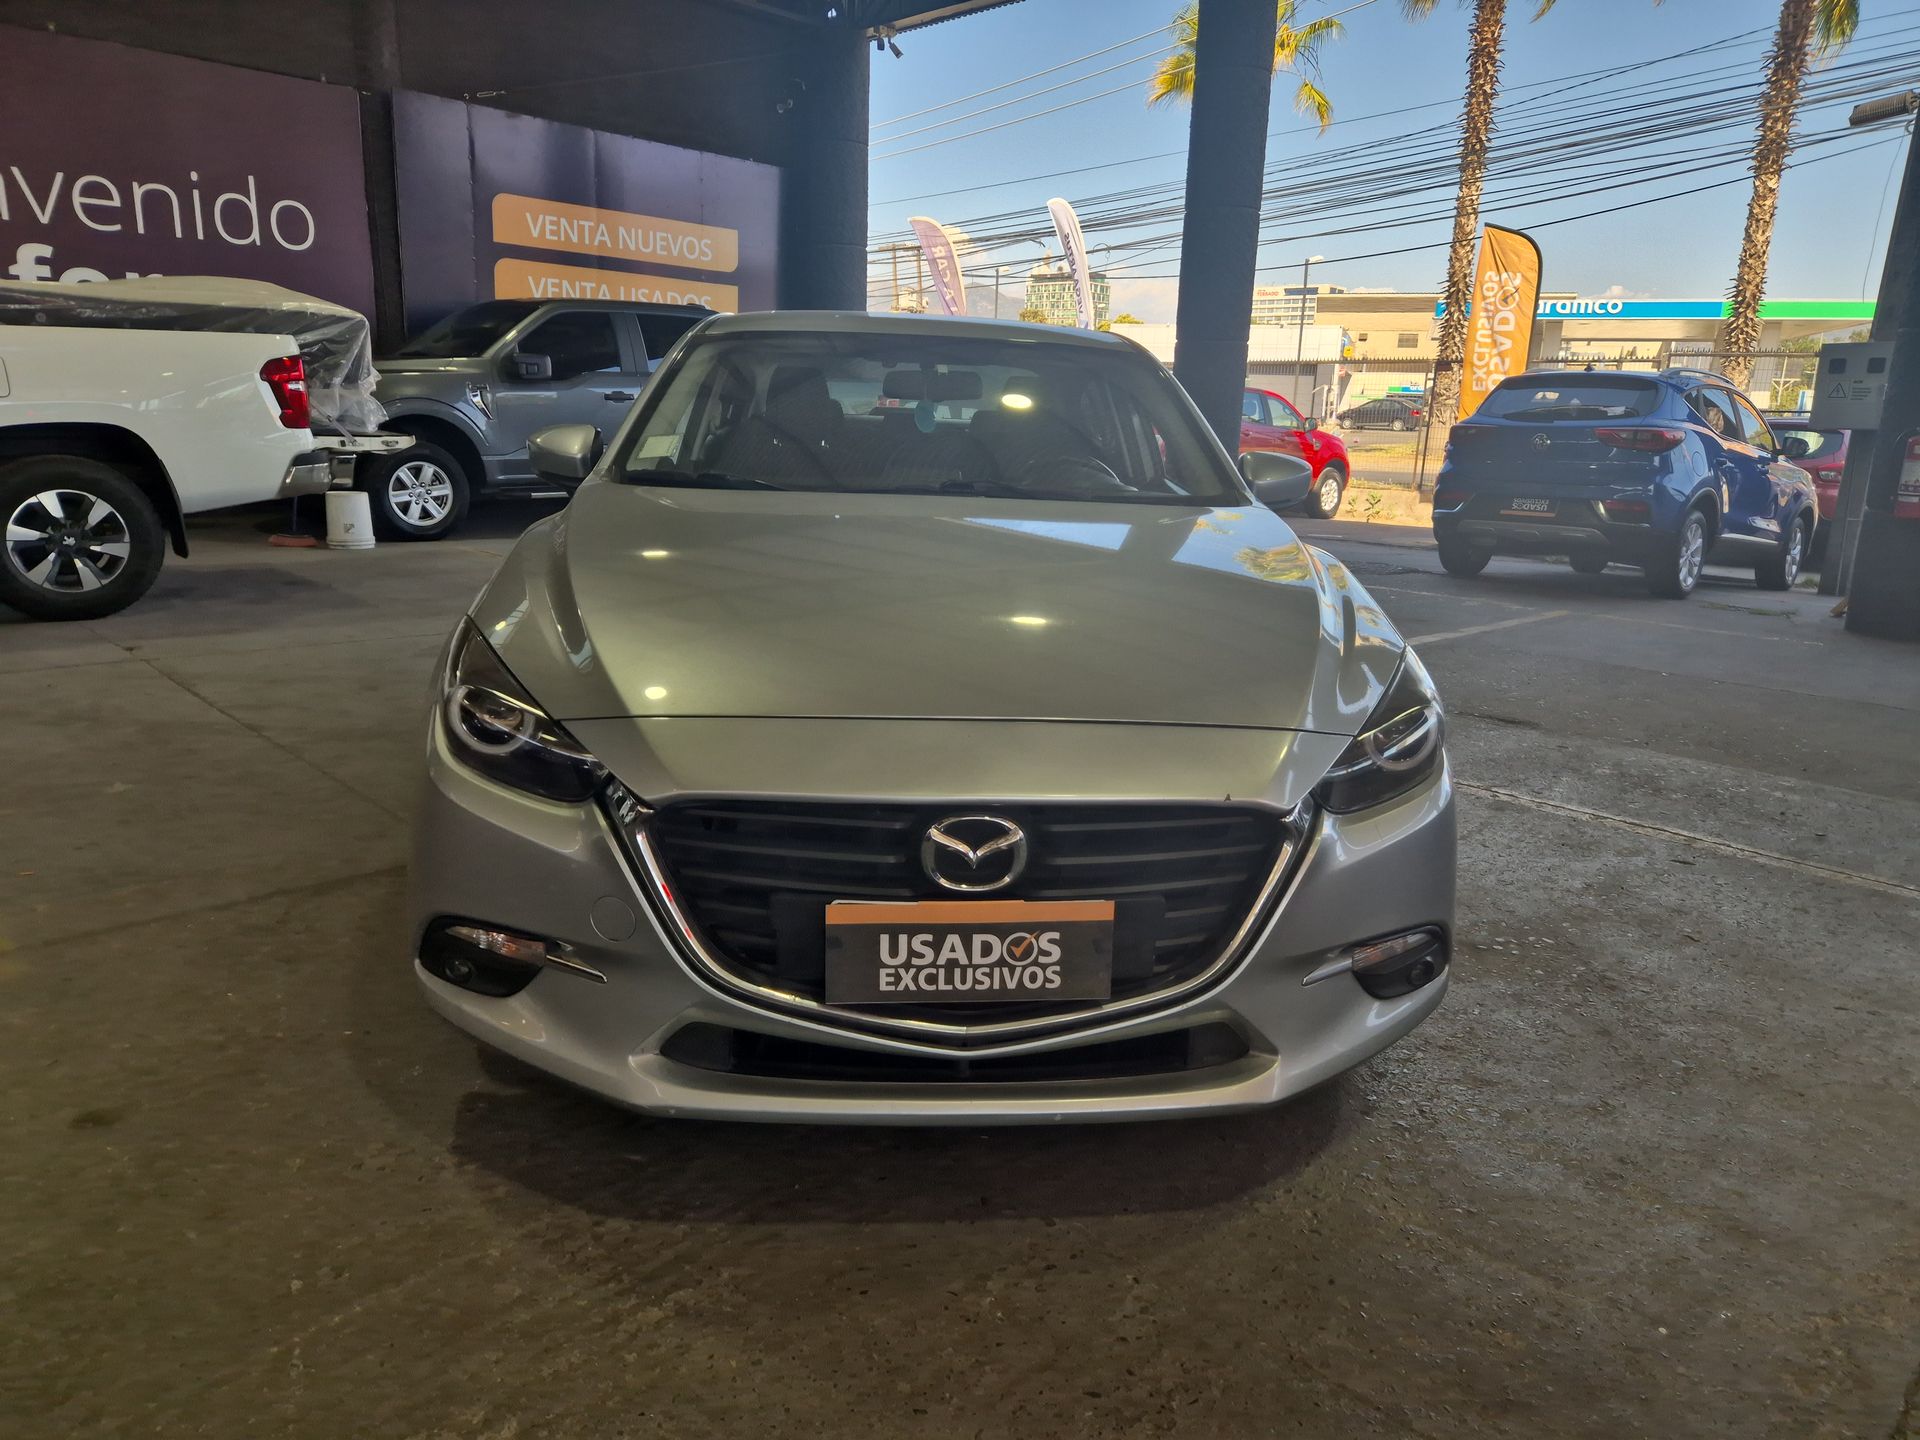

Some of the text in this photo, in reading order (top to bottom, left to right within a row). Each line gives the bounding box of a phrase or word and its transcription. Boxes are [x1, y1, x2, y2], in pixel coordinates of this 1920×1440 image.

[0, 166, 315, 251] venido
[526, 212, 713, 262] VENTA NUEVOS
[527, 275, 611, 300] VENTA
[879, 931, 1062, 966] USADOS
[879, 965, 1062, 991] EXCLUSIVOS
